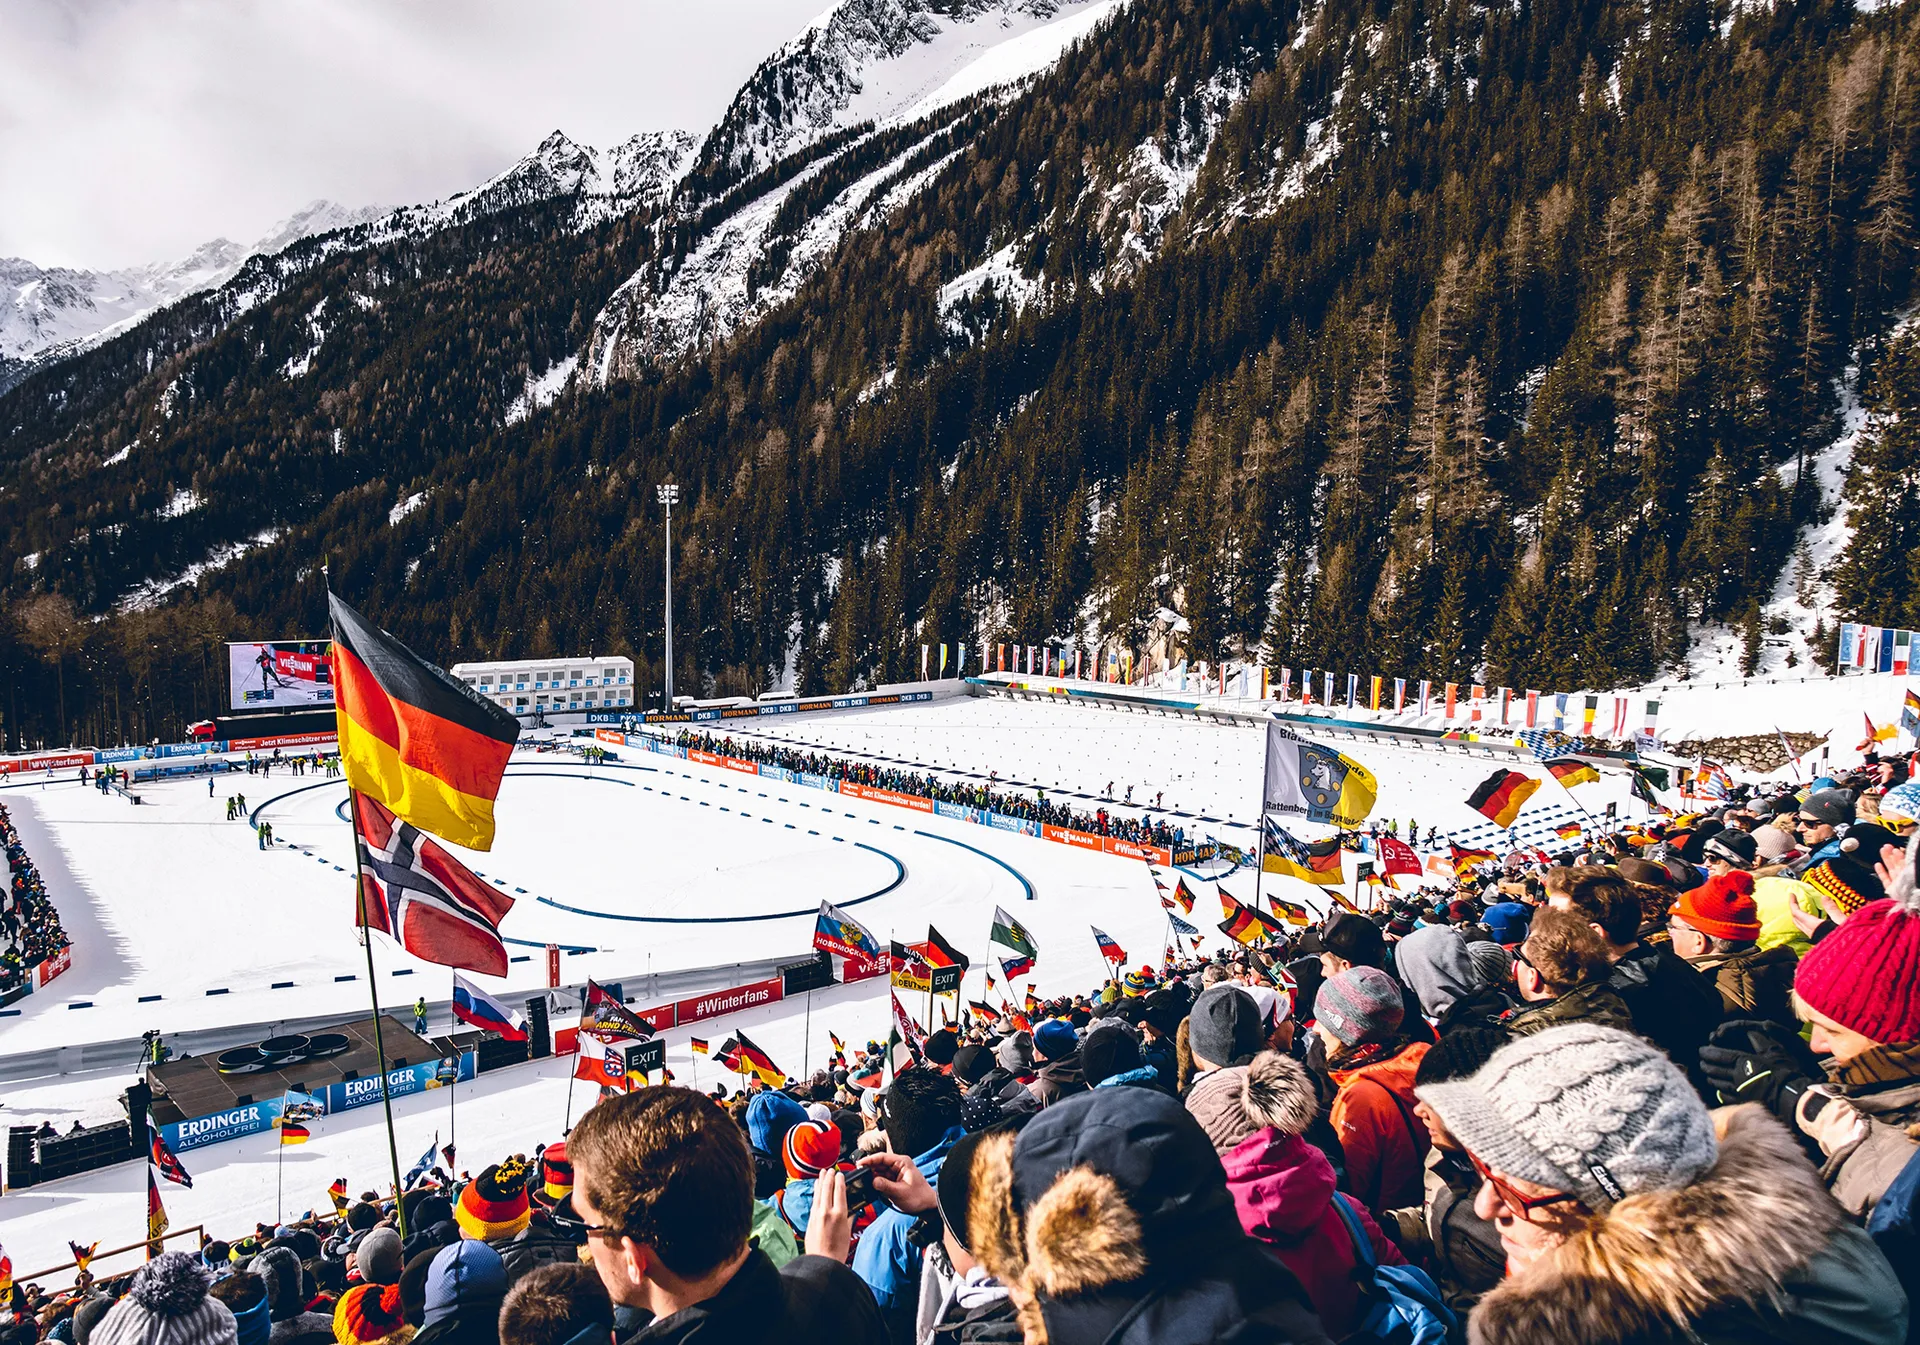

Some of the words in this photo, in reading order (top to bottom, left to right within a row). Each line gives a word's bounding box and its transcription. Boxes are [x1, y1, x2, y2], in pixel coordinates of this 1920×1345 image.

[834, 700, 846, 708] DKB
[590, 714, 609, 722] DKB
[260, 739, 276, 747] Jetzt
[1265, 801, 1312, 818] Rattenberg
[1314, 808, 1323, 817] im
[1050, 830, 1093, 845] VIESSMANN
[1115, 842, 1160, 861] #Winterns
[935, 973, 955, 985] EXIT
[696, 989, 769, 1016] #Winterfans
[596, 1021, 620, 1030] ARND
[632, 1050, 658, 1066] EXIT
[178, 1107, 260, 1138] ERDINGER
[179, 1121, 259, 1149] ALKOHOLFREI
